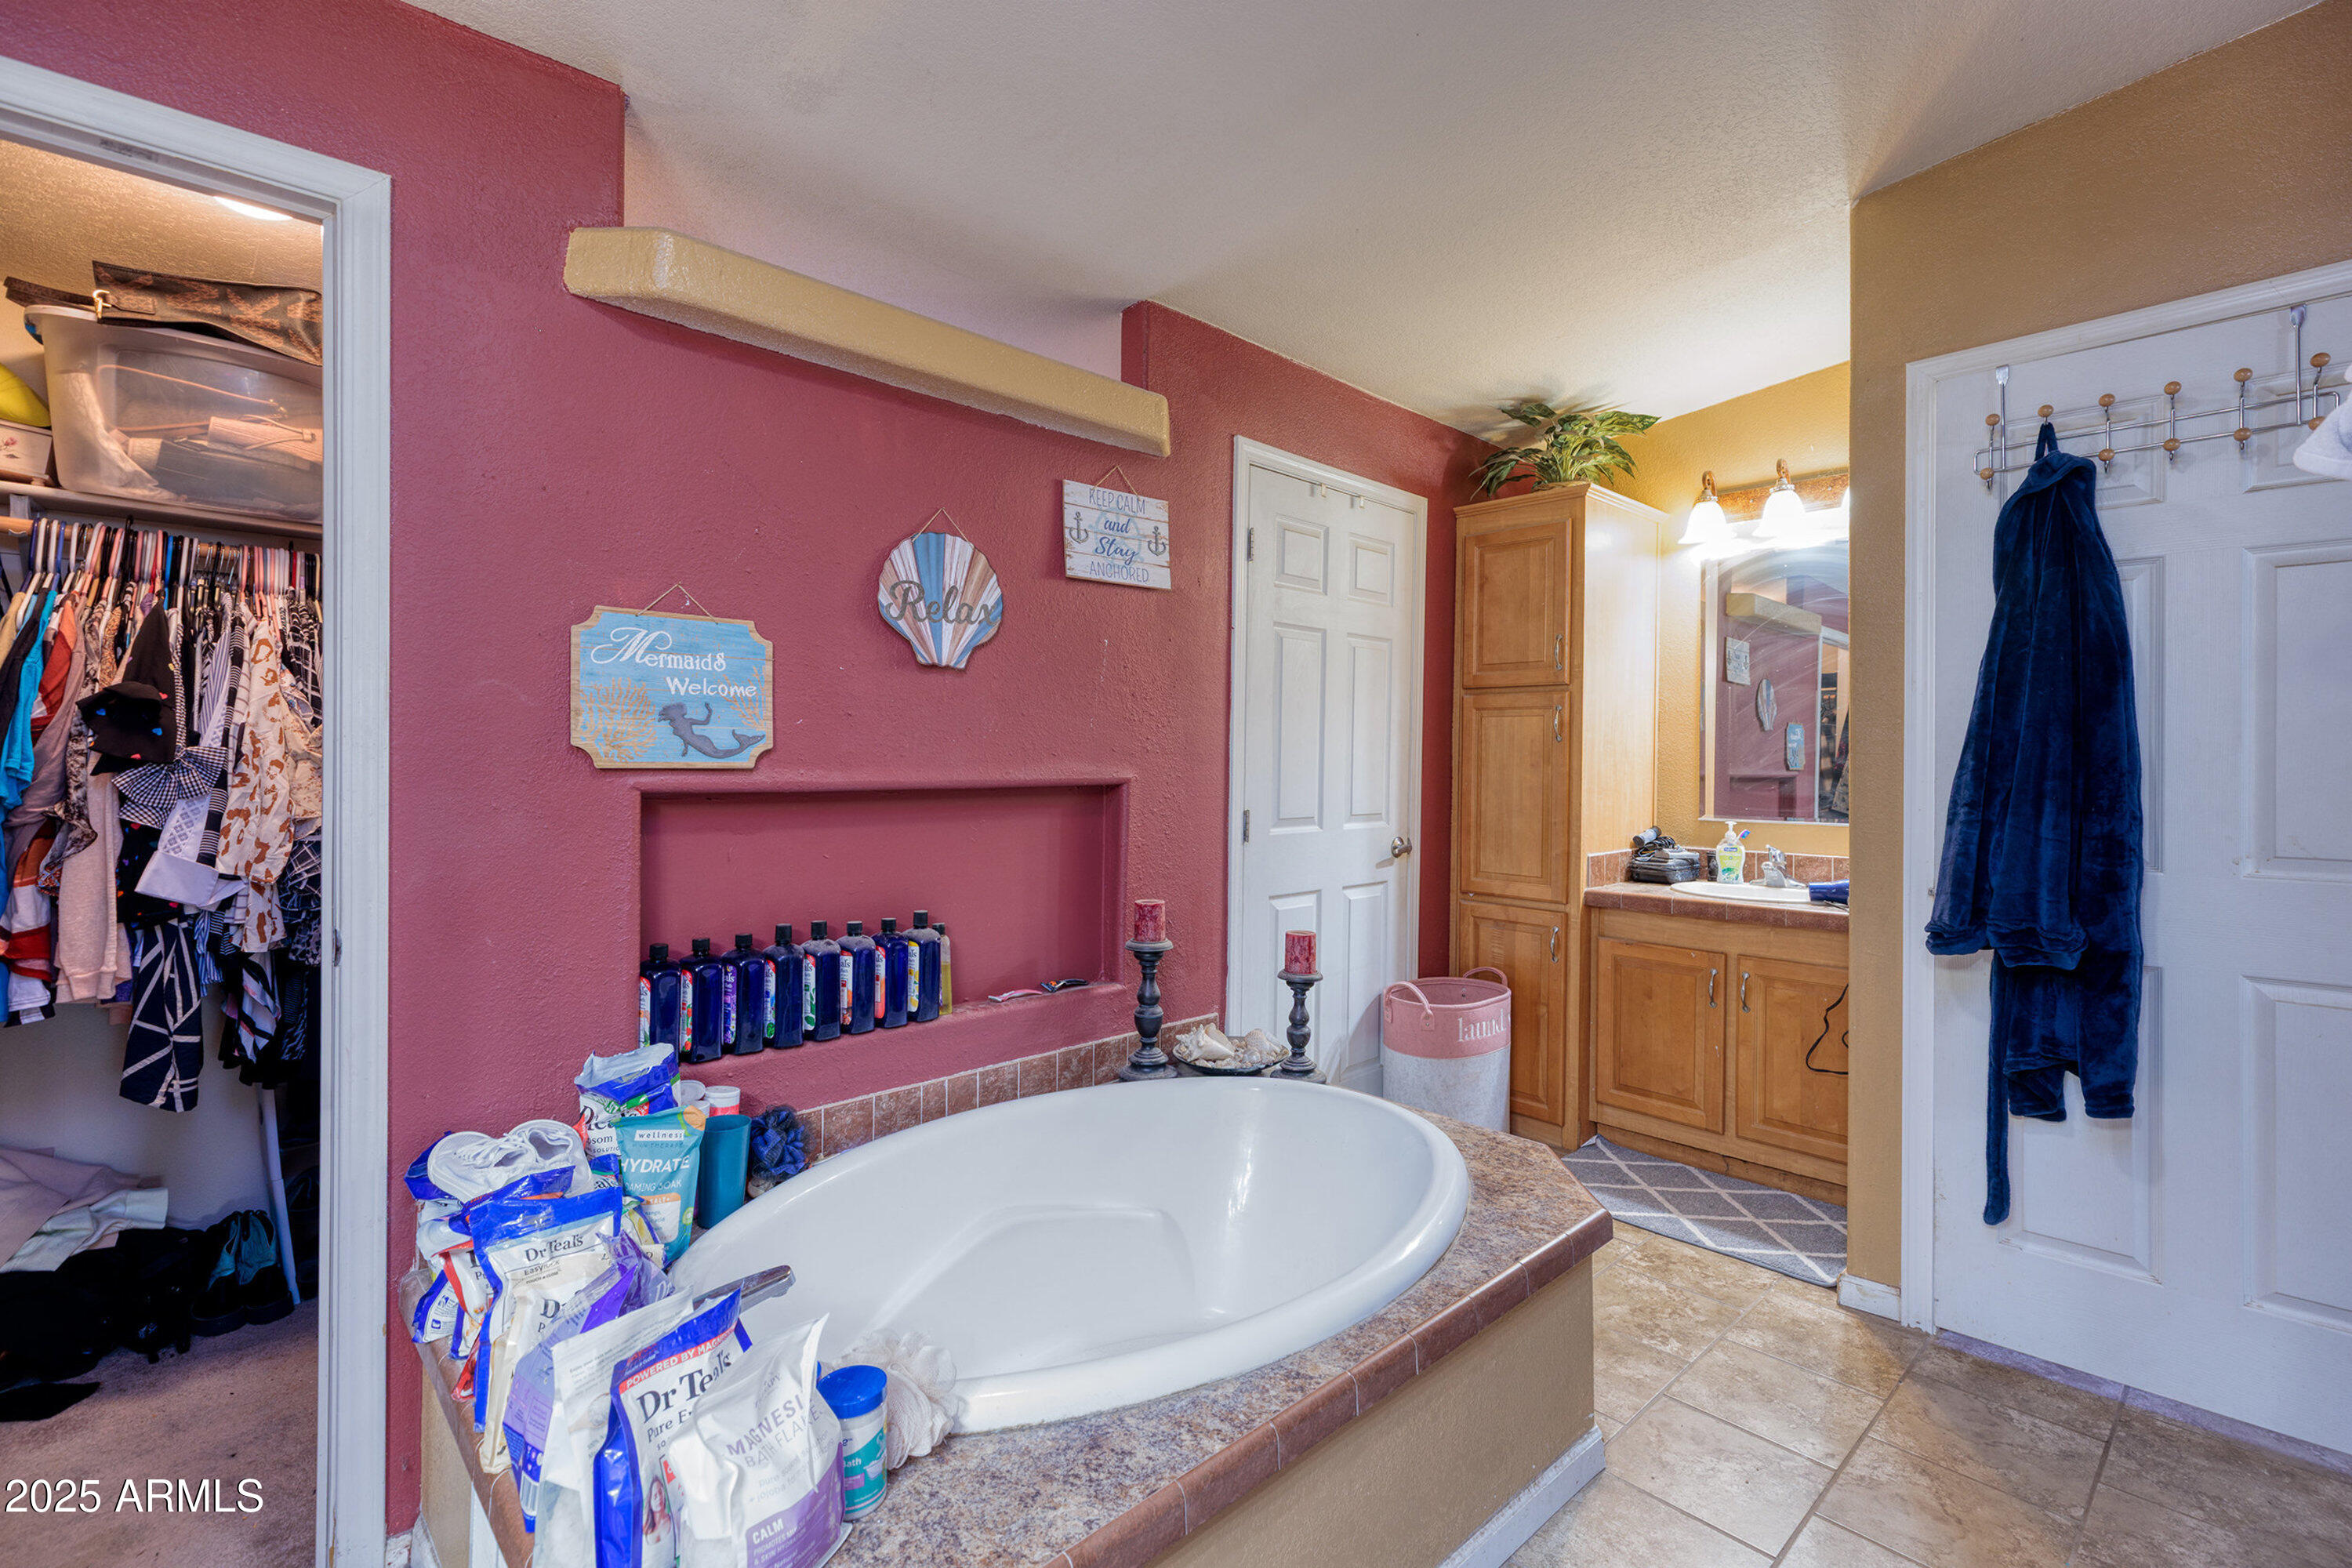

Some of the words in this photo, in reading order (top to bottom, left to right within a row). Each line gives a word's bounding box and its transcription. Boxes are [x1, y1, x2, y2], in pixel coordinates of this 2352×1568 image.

[1089, 488, 1114, 508] KEEP
[1116, 494, 1146, 515] CALM
[1104, 517, 1131, 534] and
[1094, 536, 1140, 565] Stay
[1089, 561, 1150, 583] ANCHORED
[884, 579, 1001, 626] Relax
[590, 627, 727, 672] Mermaids
[666, 677, 757, 698] Welcome
[588, 1135, 613, 1145] som
[621, 1156, 691, 1174] HYDRATE
[626, 1183, 656, 1192] OAMING
[658, 1179, 682, 1190] SOAK
[524, 1247, 547, 1262] Dr
[548, 1233, 584, 1254] Teal's
[626, 1356, 678, 1388] POWERED
[681, 1350, 695, 1363] BY
[637, 1388, 677, 1424] Dr
[679, 1349, 731, 1402] Teal's
[647, 1419, 673, 1443] Pure
[726, 1394, 804, 1456] MAGNESI
[745, 1440, 778, 1468] BATH
[752, 1518, 784, 1544] CALM
